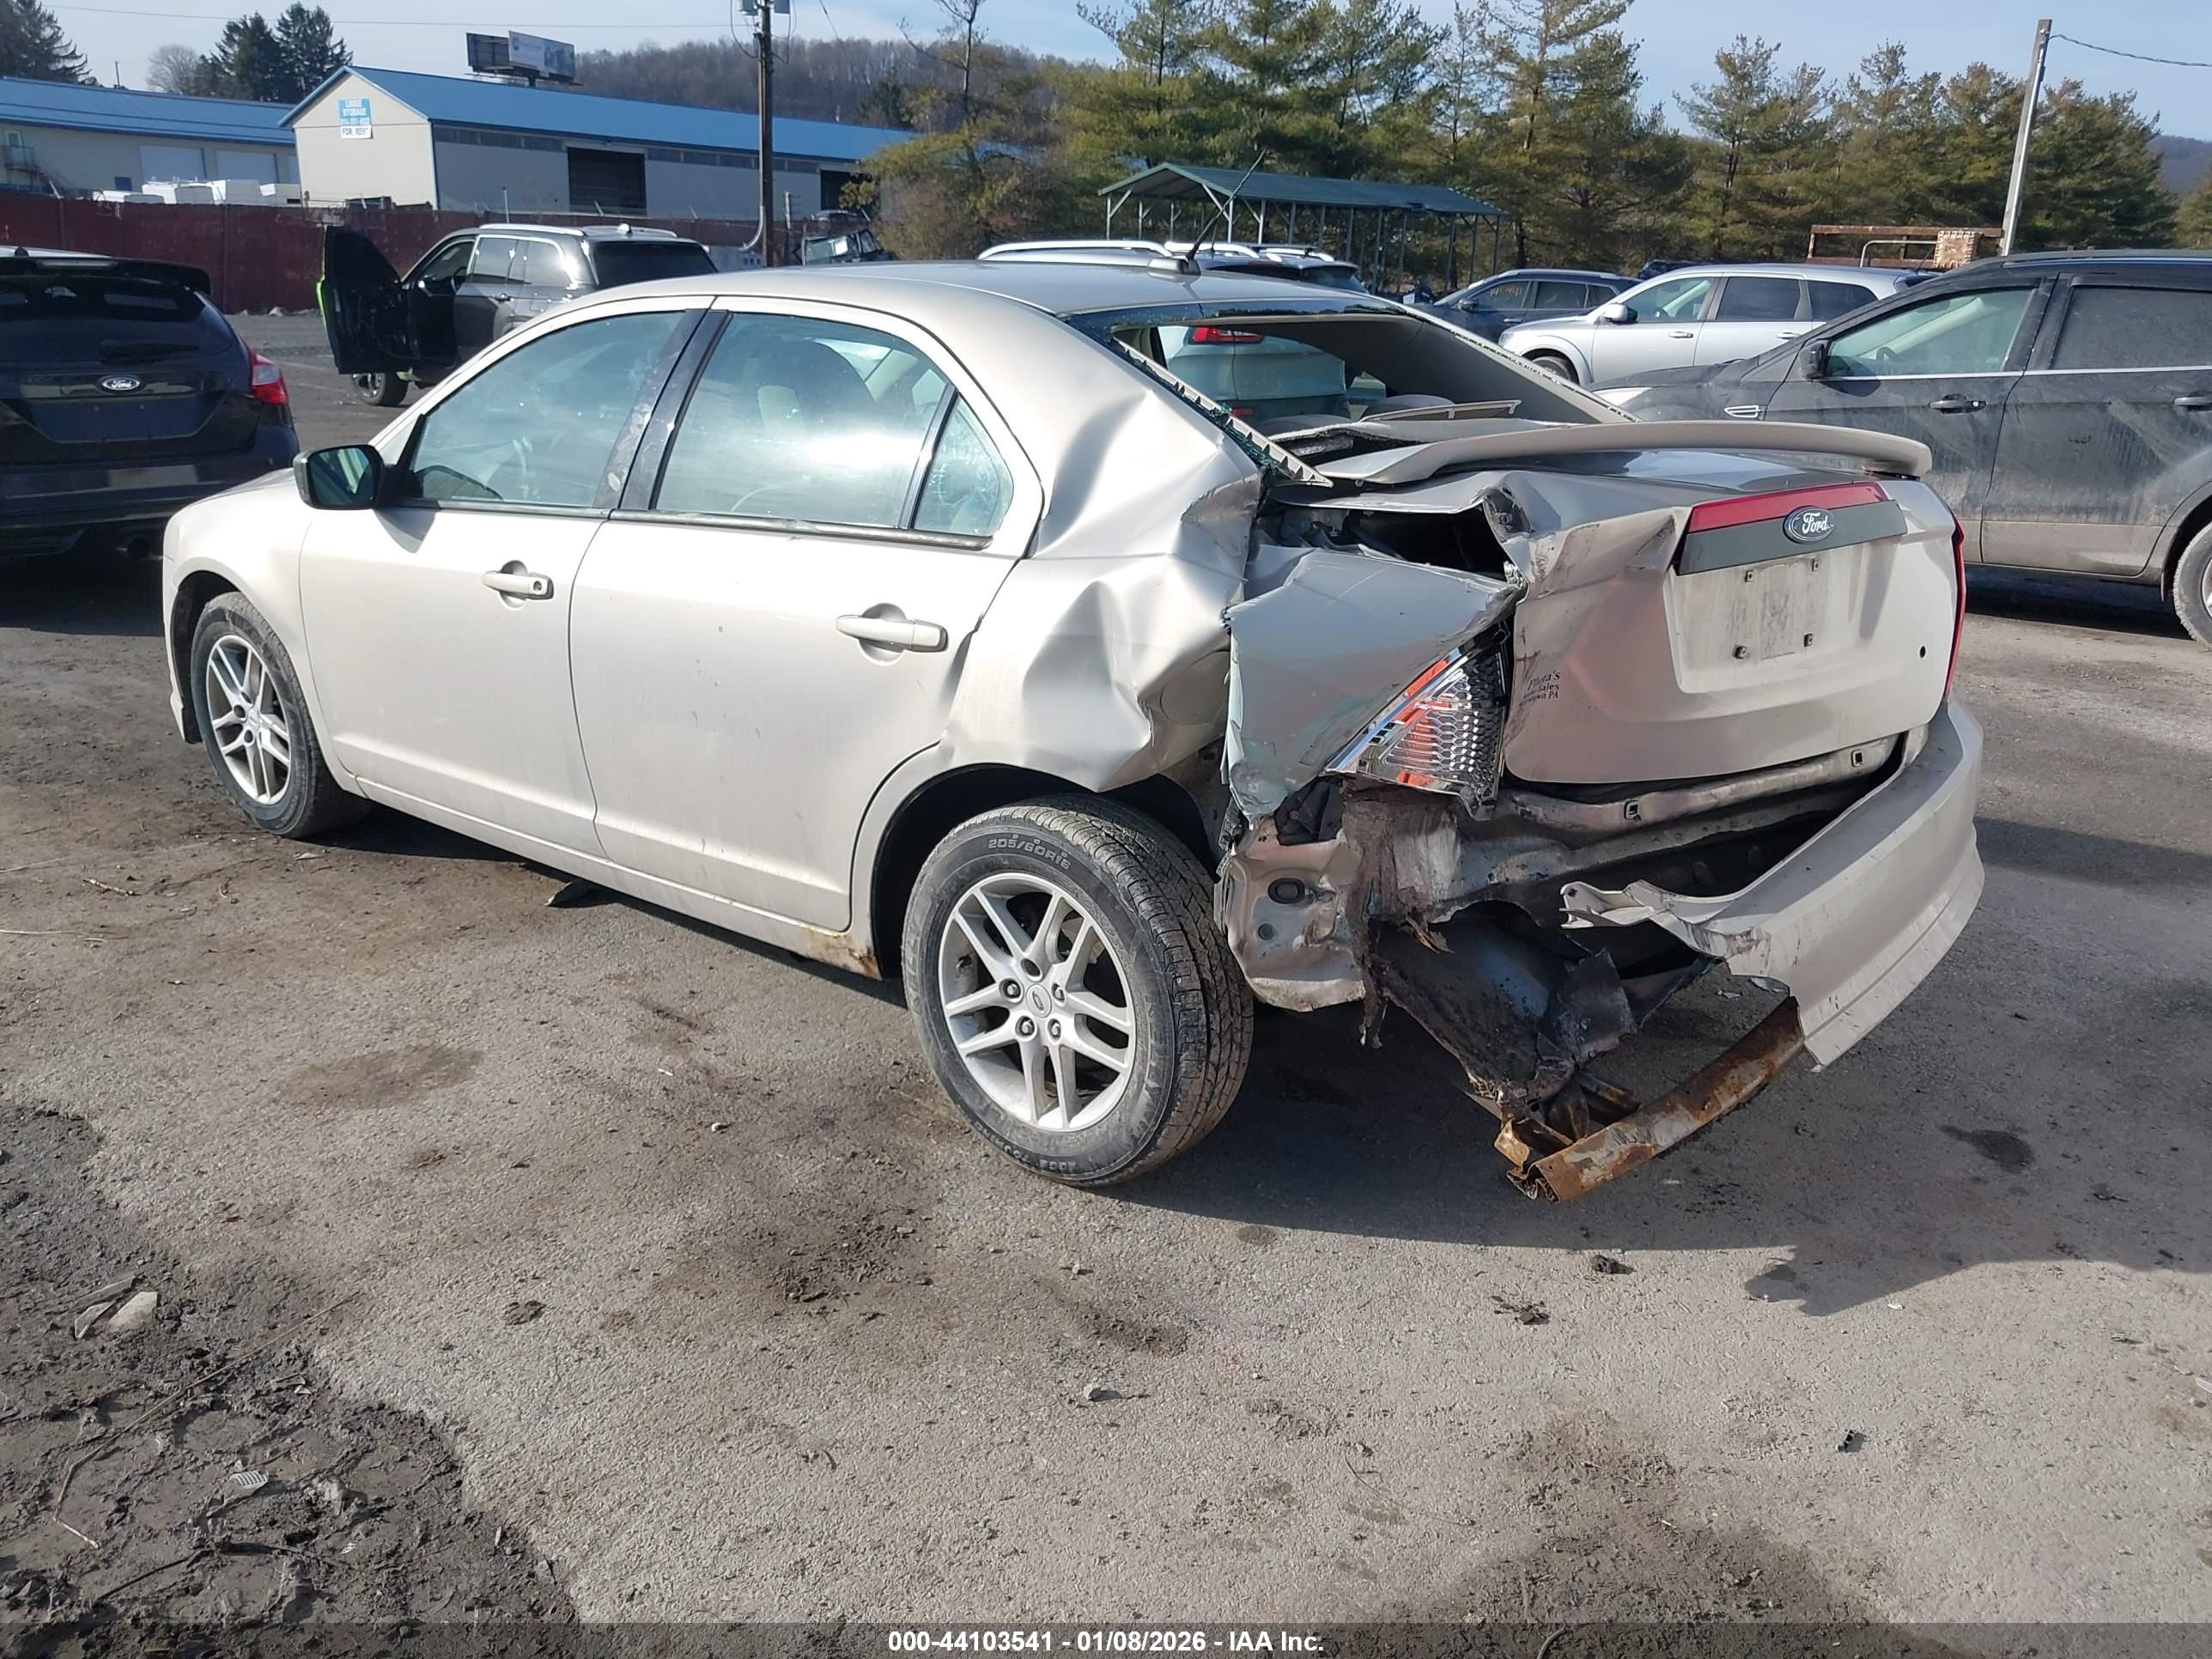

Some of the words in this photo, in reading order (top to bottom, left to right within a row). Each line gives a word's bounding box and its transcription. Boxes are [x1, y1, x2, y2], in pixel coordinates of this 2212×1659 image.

[343, 127, 353, 136] FOR
[1802, 512, 1831, 534] Ford
[1548, 690, 1559, 699] PA
[988, 838, 1072, 871] 205/60R16
